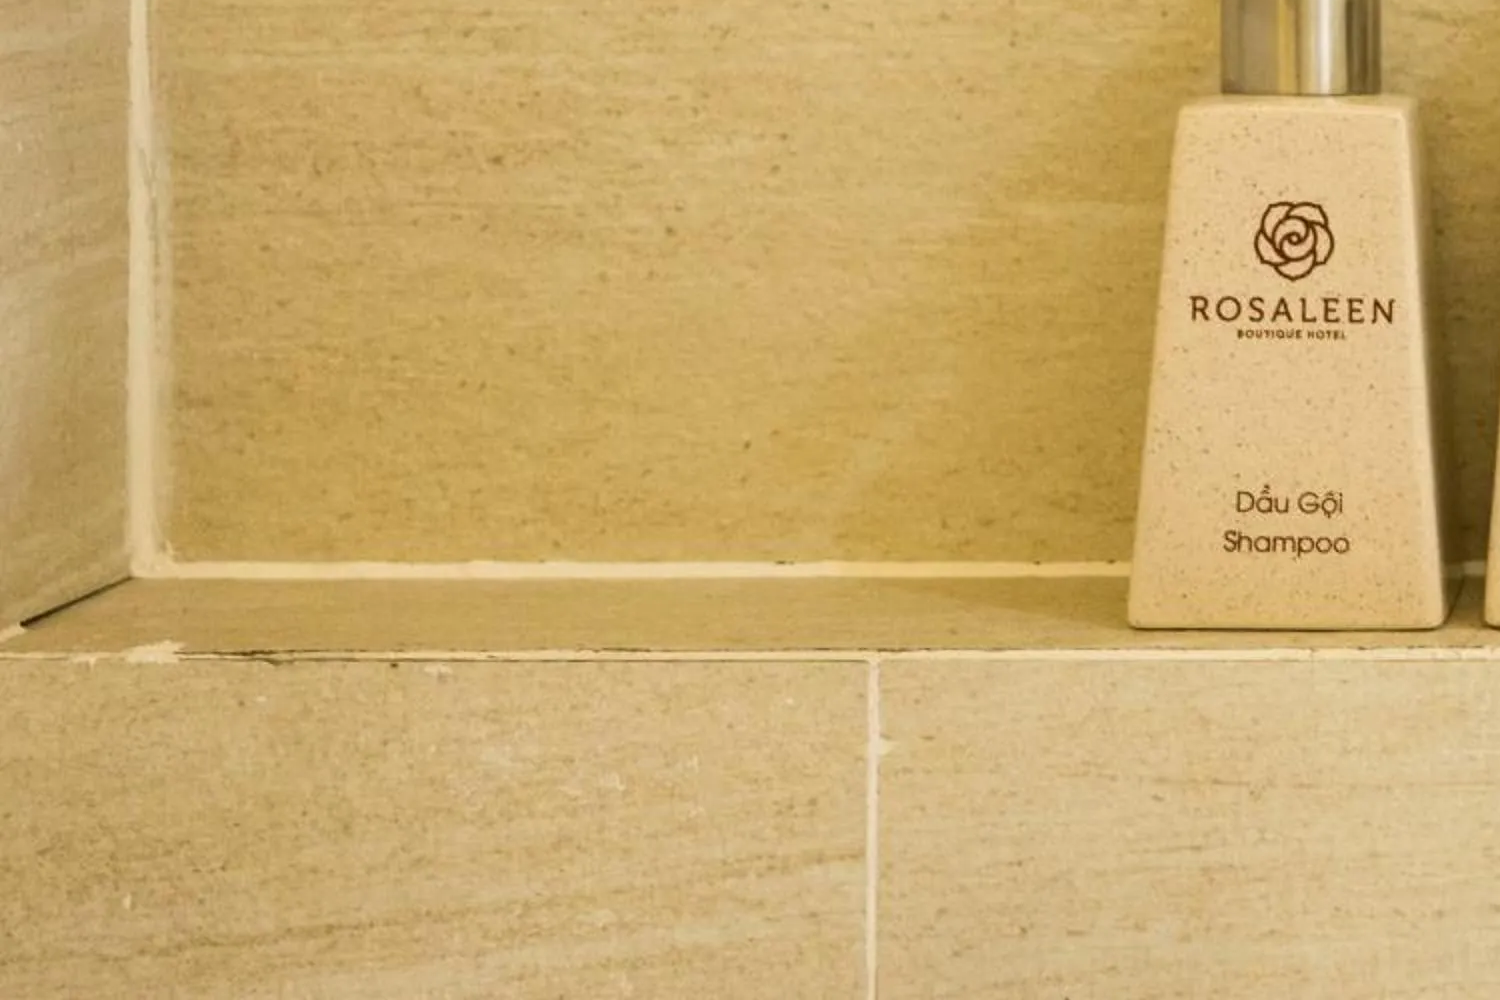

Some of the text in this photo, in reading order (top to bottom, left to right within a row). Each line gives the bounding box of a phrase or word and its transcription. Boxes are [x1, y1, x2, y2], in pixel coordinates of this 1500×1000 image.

[1189, 295, 1395, 324] ROSALEEN
[1236, 329, 1346, 340] BOUTIQUE HOTEL
[1297, 490, 1344, 519] Gội
[1223, 529, 1350, 558] Shampoo
